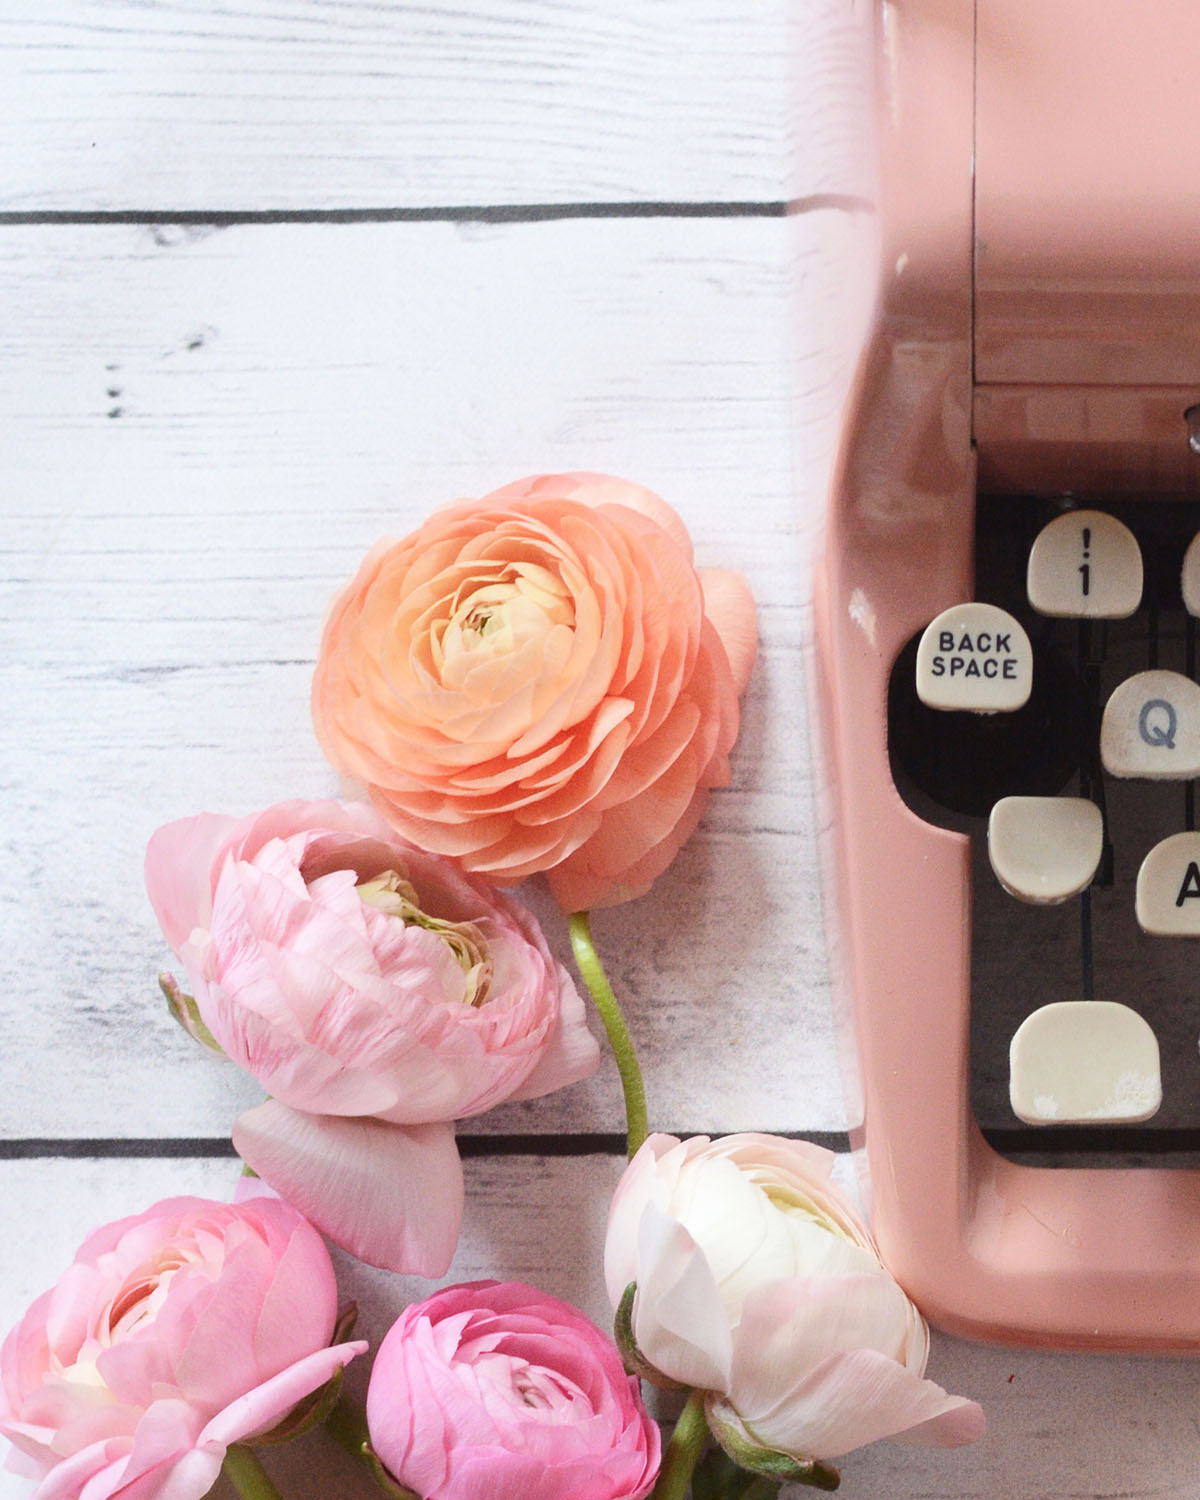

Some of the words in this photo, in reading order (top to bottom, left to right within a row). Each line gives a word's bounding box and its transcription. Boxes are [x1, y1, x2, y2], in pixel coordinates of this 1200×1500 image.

[938, 631, 1012, 654] BACK
[930, 656, 1018, 681] SPACE
[1137, 698, 1177, 750] Q
